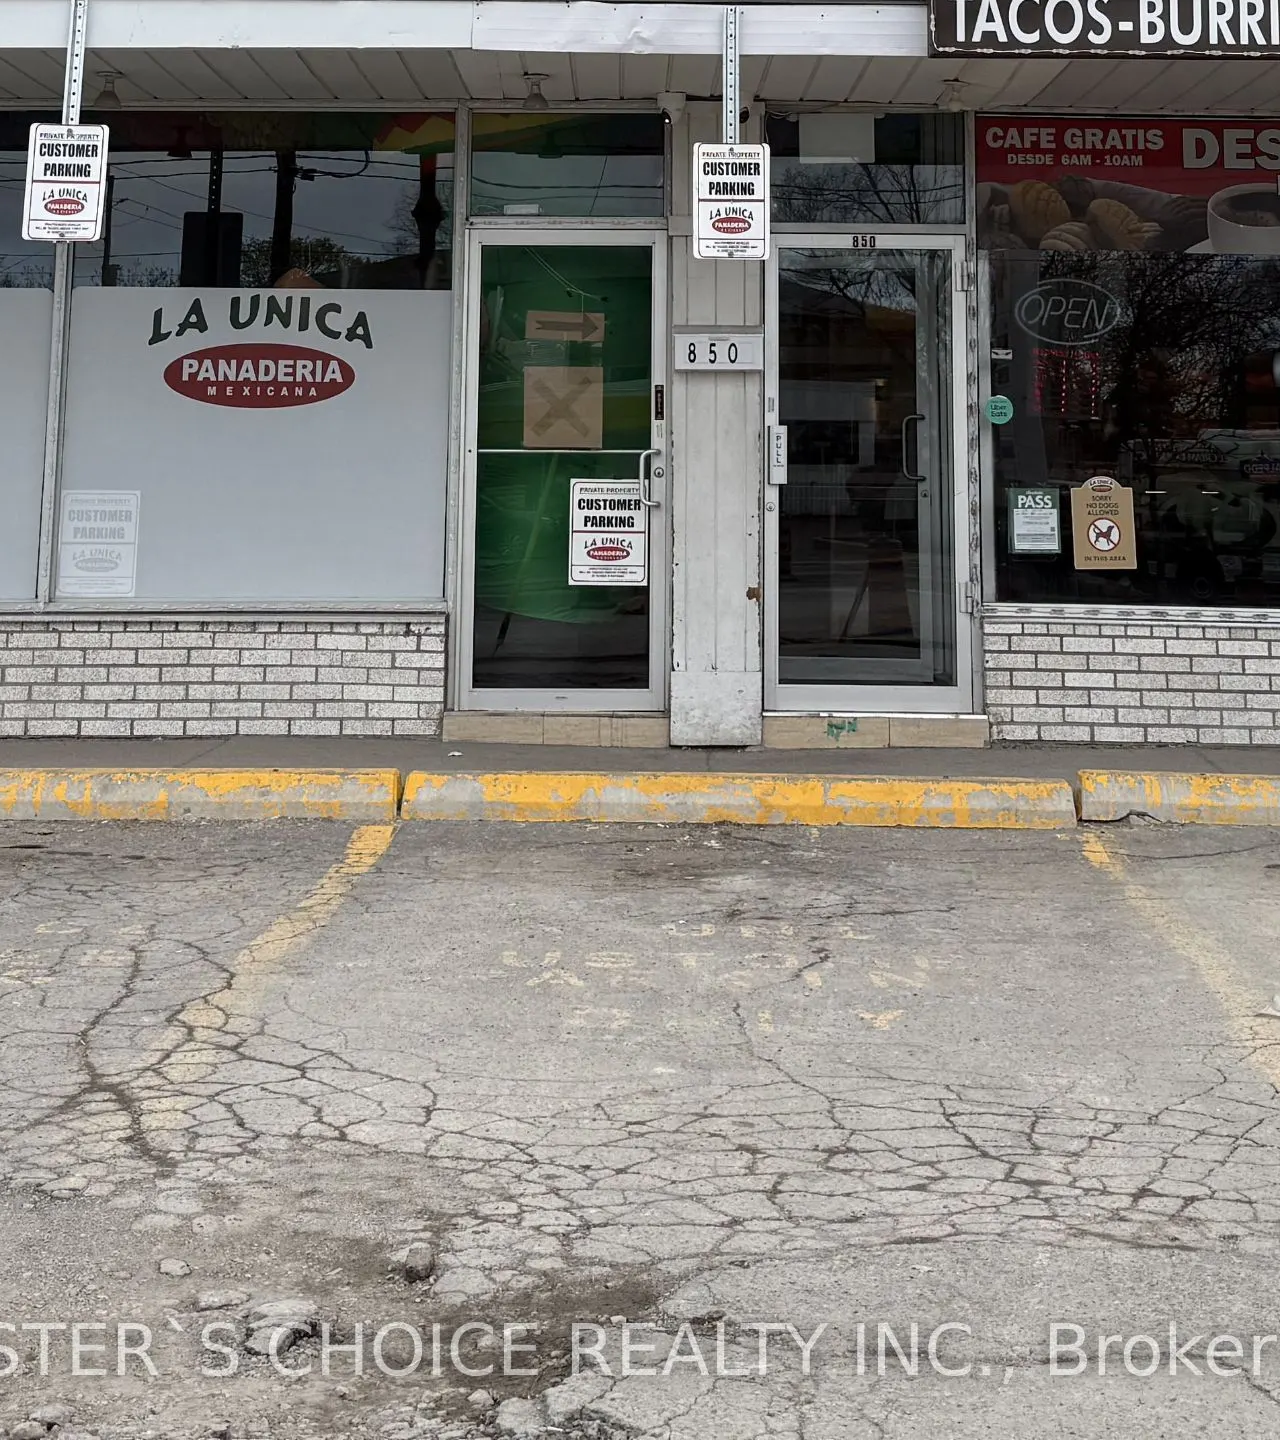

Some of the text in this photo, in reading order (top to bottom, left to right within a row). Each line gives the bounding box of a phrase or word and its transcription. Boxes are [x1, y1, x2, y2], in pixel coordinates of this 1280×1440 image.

[985, 127, 1164, 151] CAFE GRATIS
[40, 143, 98, 157] CUSTOMER
[1008, 153, 1143, 166] DESDE 6AM 10AM
[44, 163, 91, 177] PARKING
[703, 162, 760, 176] CUSTOMER
[43, 188, 87, 202] LA UNICA
[709, 182, 754, 196] PARKING
[710, 207, 754, 220] LA UNICA
[853, 236, 876, 248] 850
[1022, 294, 1110, 330] OPEN
[148, 294, 373, 349] LA UNICA
[688, 343, 738, 364] 850
[182, 358, 343, 383] PANADERIA
[207, 386, 317, 397] MEXICANA
[578, 499, 640, 510] CUSTOMER
[1017, 495, 1052, 508] PASS
[68, 510, 132, 522] CUSTOMER
[584, 516, 634, 528] PARKING
[73, 527, 125, 539] PARKING
[584, 537, 633, 549] LA UNICA
